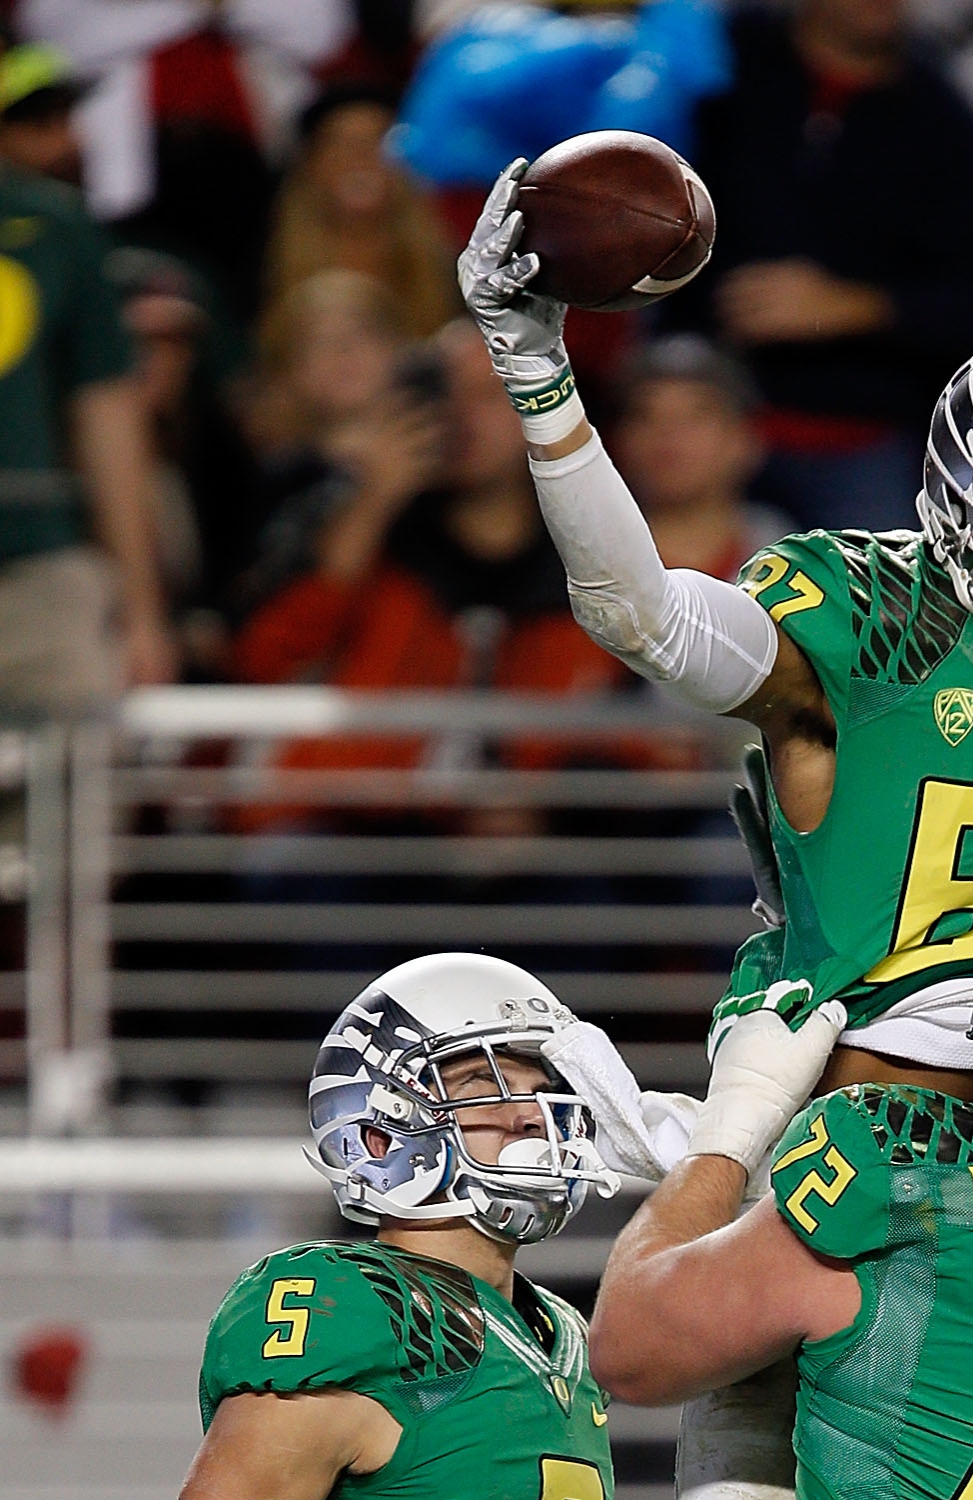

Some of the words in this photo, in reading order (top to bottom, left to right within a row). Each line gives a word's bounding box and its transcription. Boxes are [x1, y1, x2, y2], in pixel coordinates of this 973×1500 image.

[944, 711, 966, 734] 12
[771, 1113, 858, 1236] 72
[261, 1276, 317, 1360] 5
